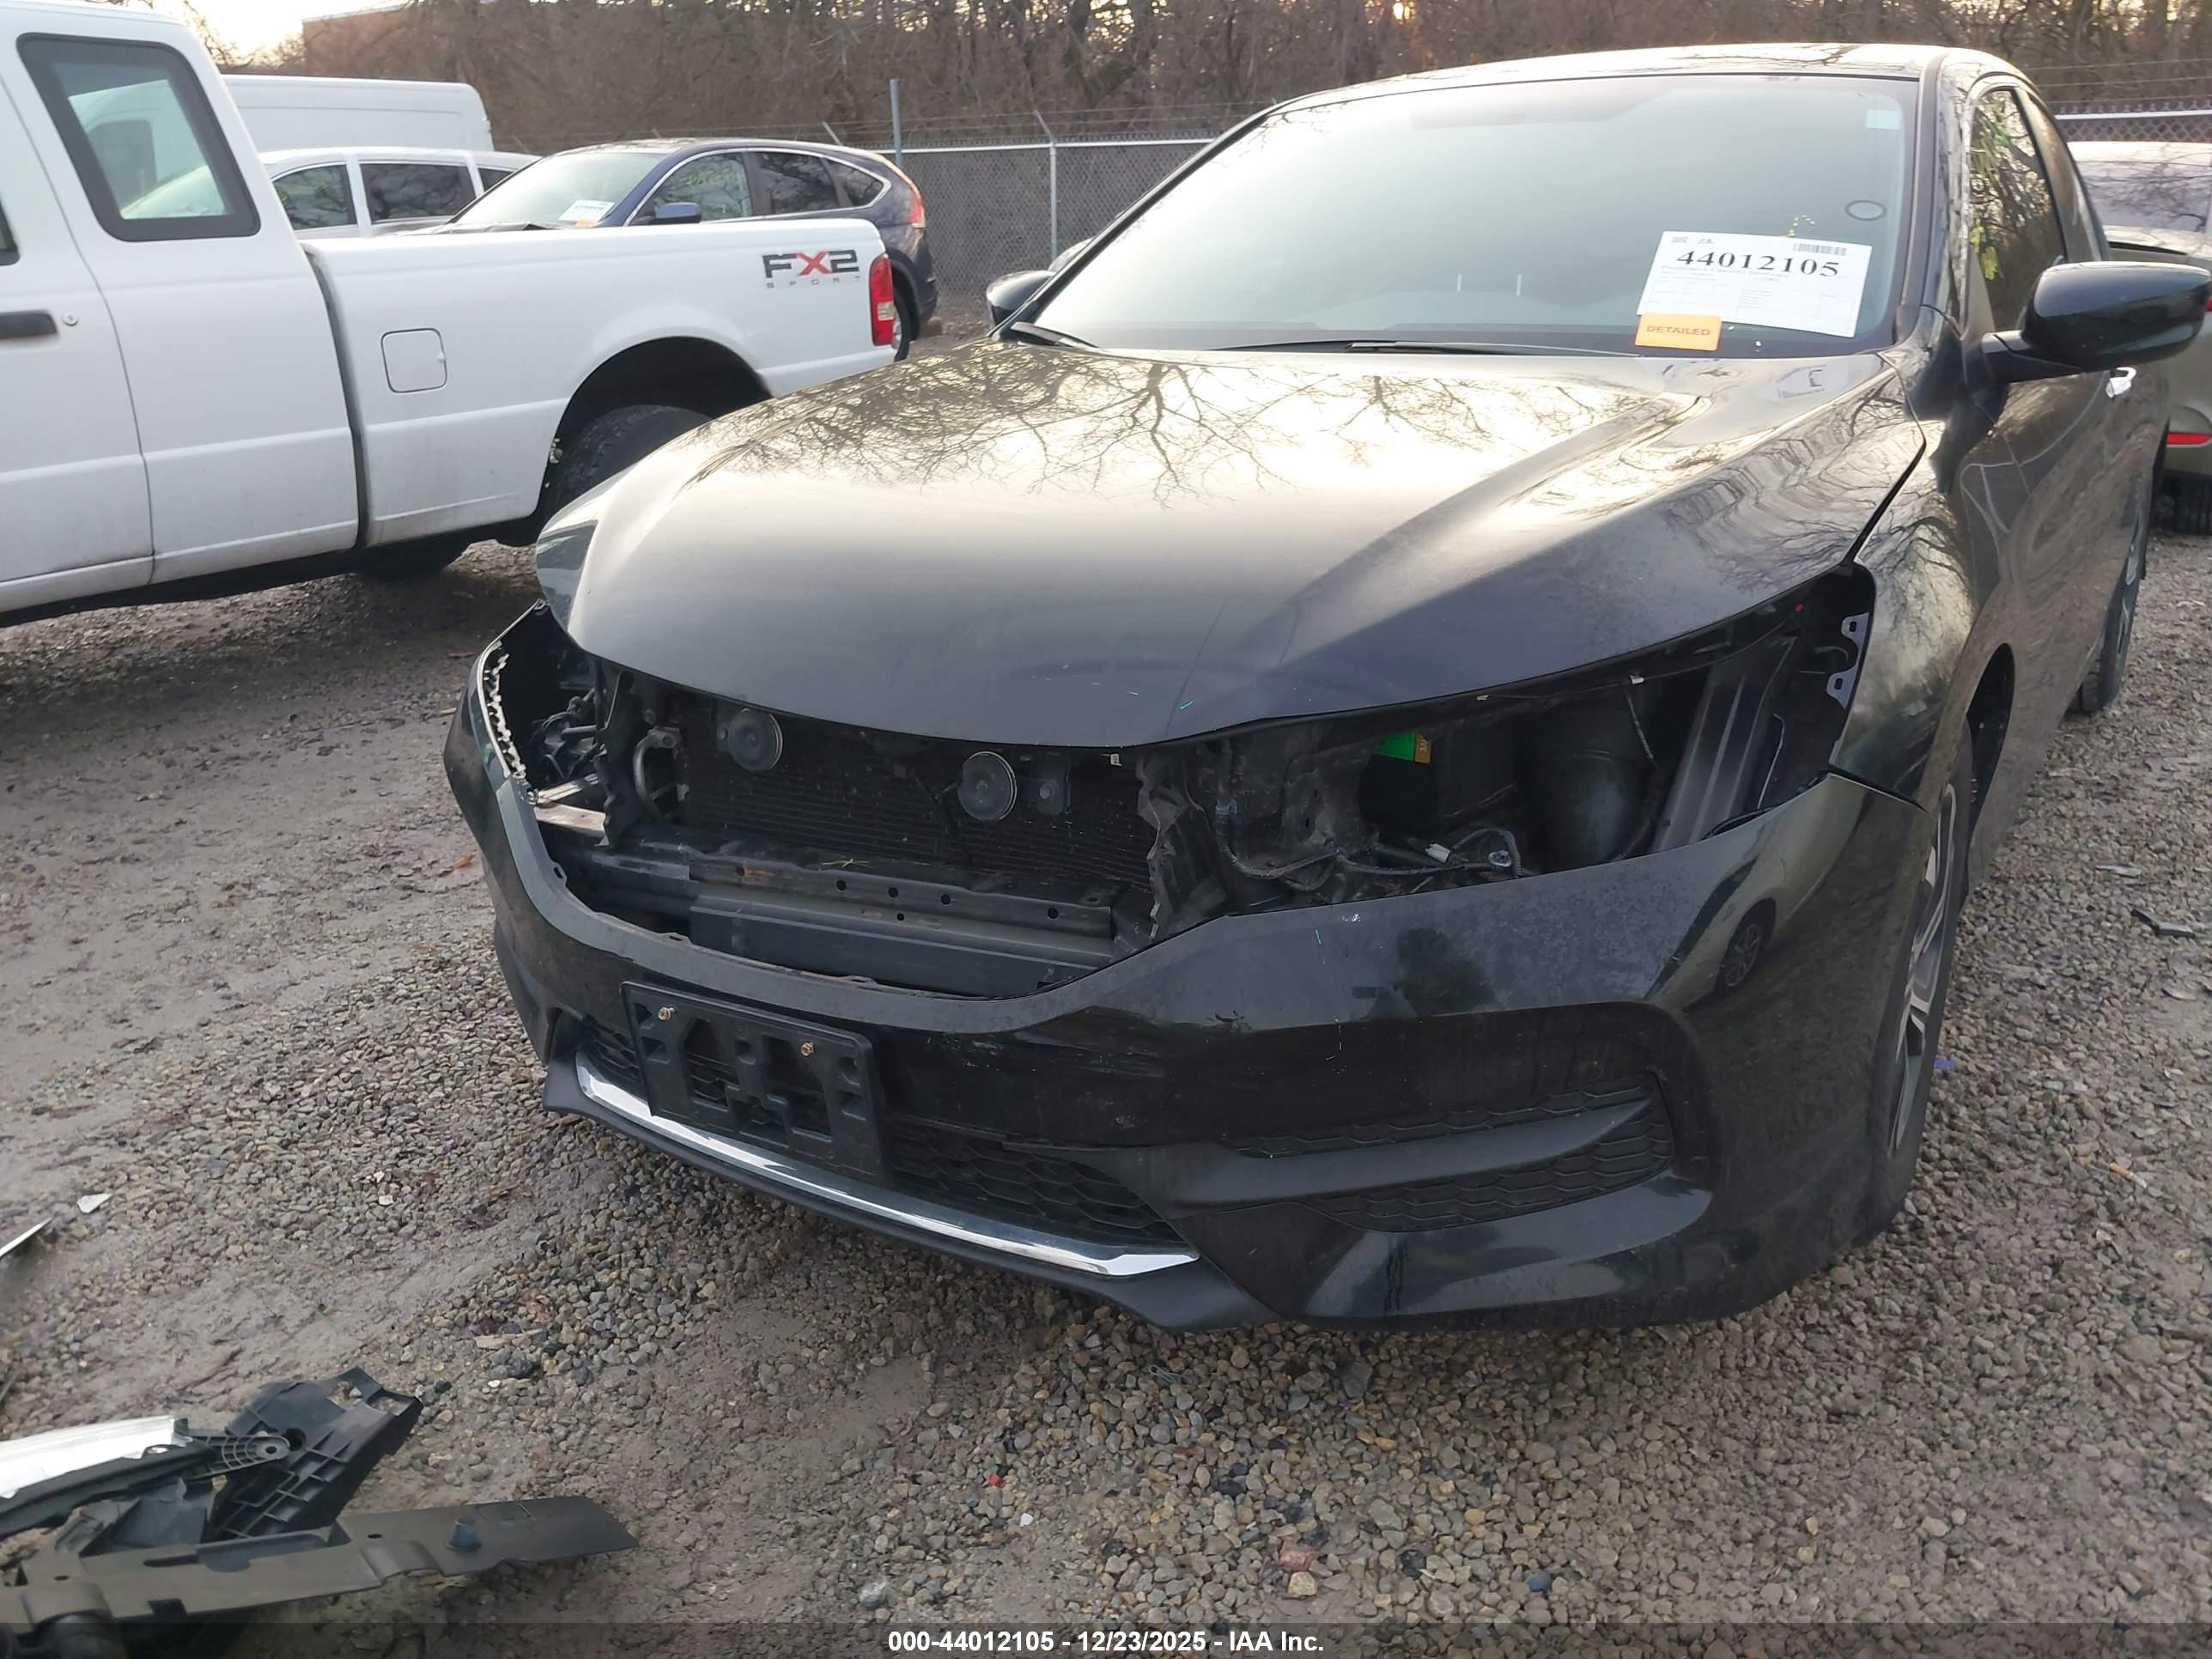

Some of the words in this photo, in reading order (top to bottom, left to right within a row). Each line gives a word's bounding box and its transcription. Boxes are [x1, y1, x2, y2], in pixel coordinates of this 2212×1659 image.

[763, 249, 860, 279] FX2
[1676, 250, 1840, 277] 44012105
[766, 275, 861, 289] SPORT
[1646, 325, 1711, 336] DETAILED
